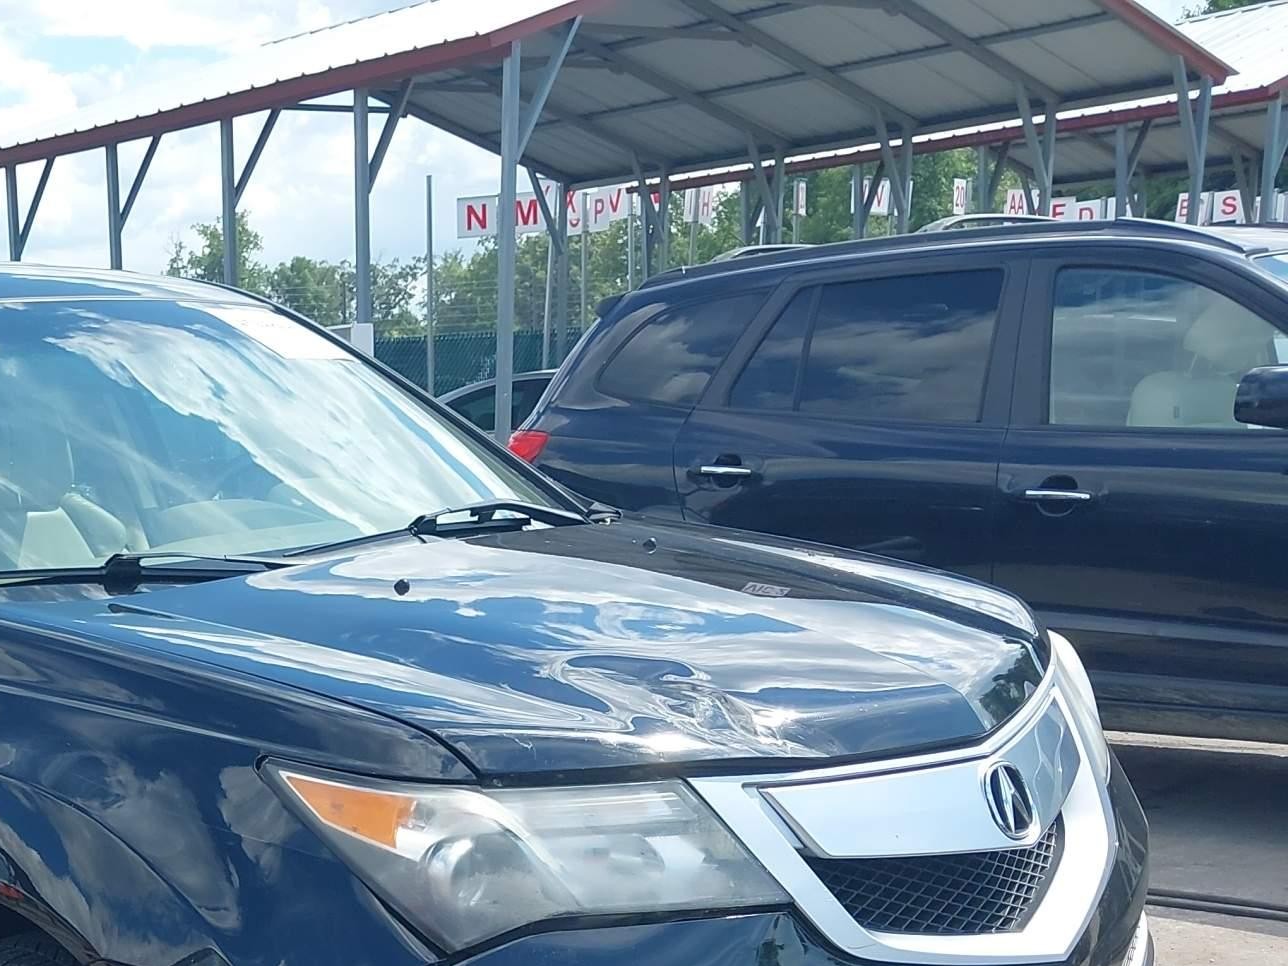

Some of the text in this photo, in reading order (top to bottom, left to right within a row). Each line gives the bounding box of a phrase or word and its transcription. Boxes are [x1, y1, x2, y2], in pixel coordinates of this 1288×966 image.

[466, 203, 487, 231] N
[515, 199, 538, 227] M
[1221, 196, 1237, 215] S
